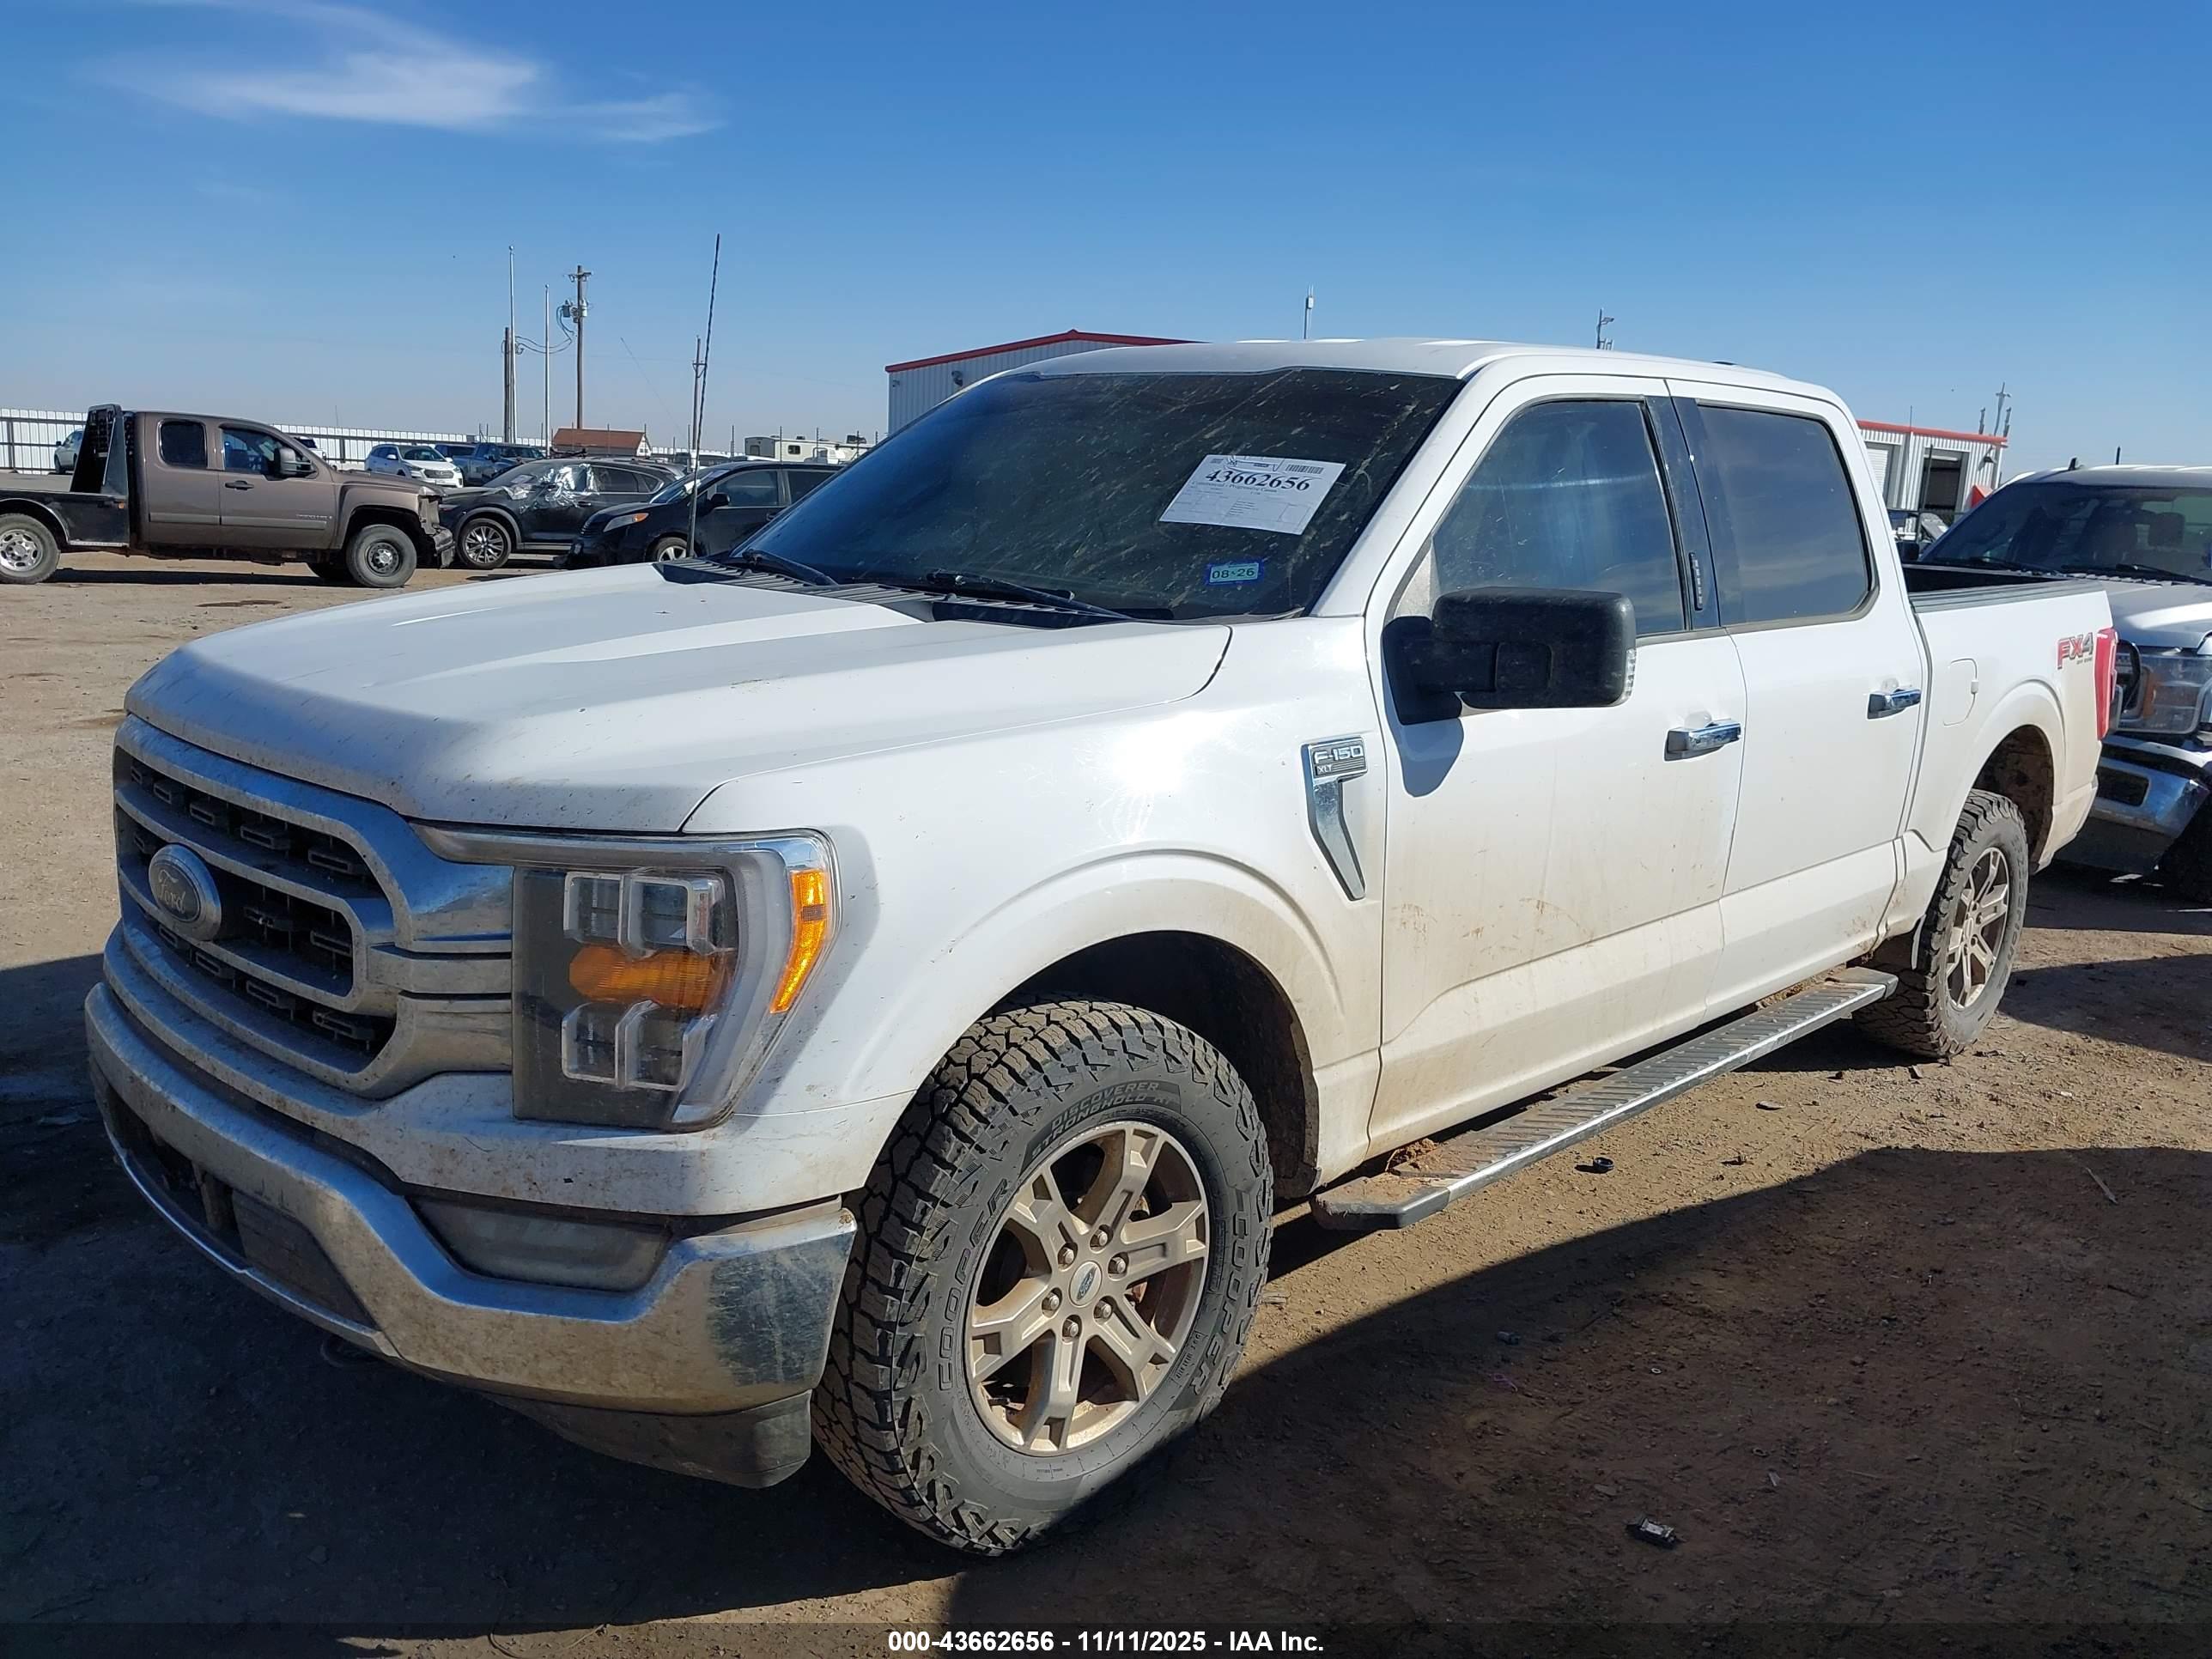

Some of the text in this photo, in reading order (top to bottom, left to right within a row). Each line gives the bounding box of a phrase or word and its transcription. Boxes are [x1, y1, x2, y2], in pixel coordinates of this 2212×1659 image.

[1205, 469, 1311, 491] 43662656
[2057, 632, 2094, 670] FX4
[1314, 744, 1364, 764] F-150
[1316, 764, 1333, 774] XLT
[157, 868, 186, 915] Ford
[1050, 1082, 1159, 1131] DISCOVERER
[935, 1178, 1012, 1393] COOPER
[1079, 1272, 1094, 1297] Ford
[1189, 1211, 1249, 1396] COOPER
